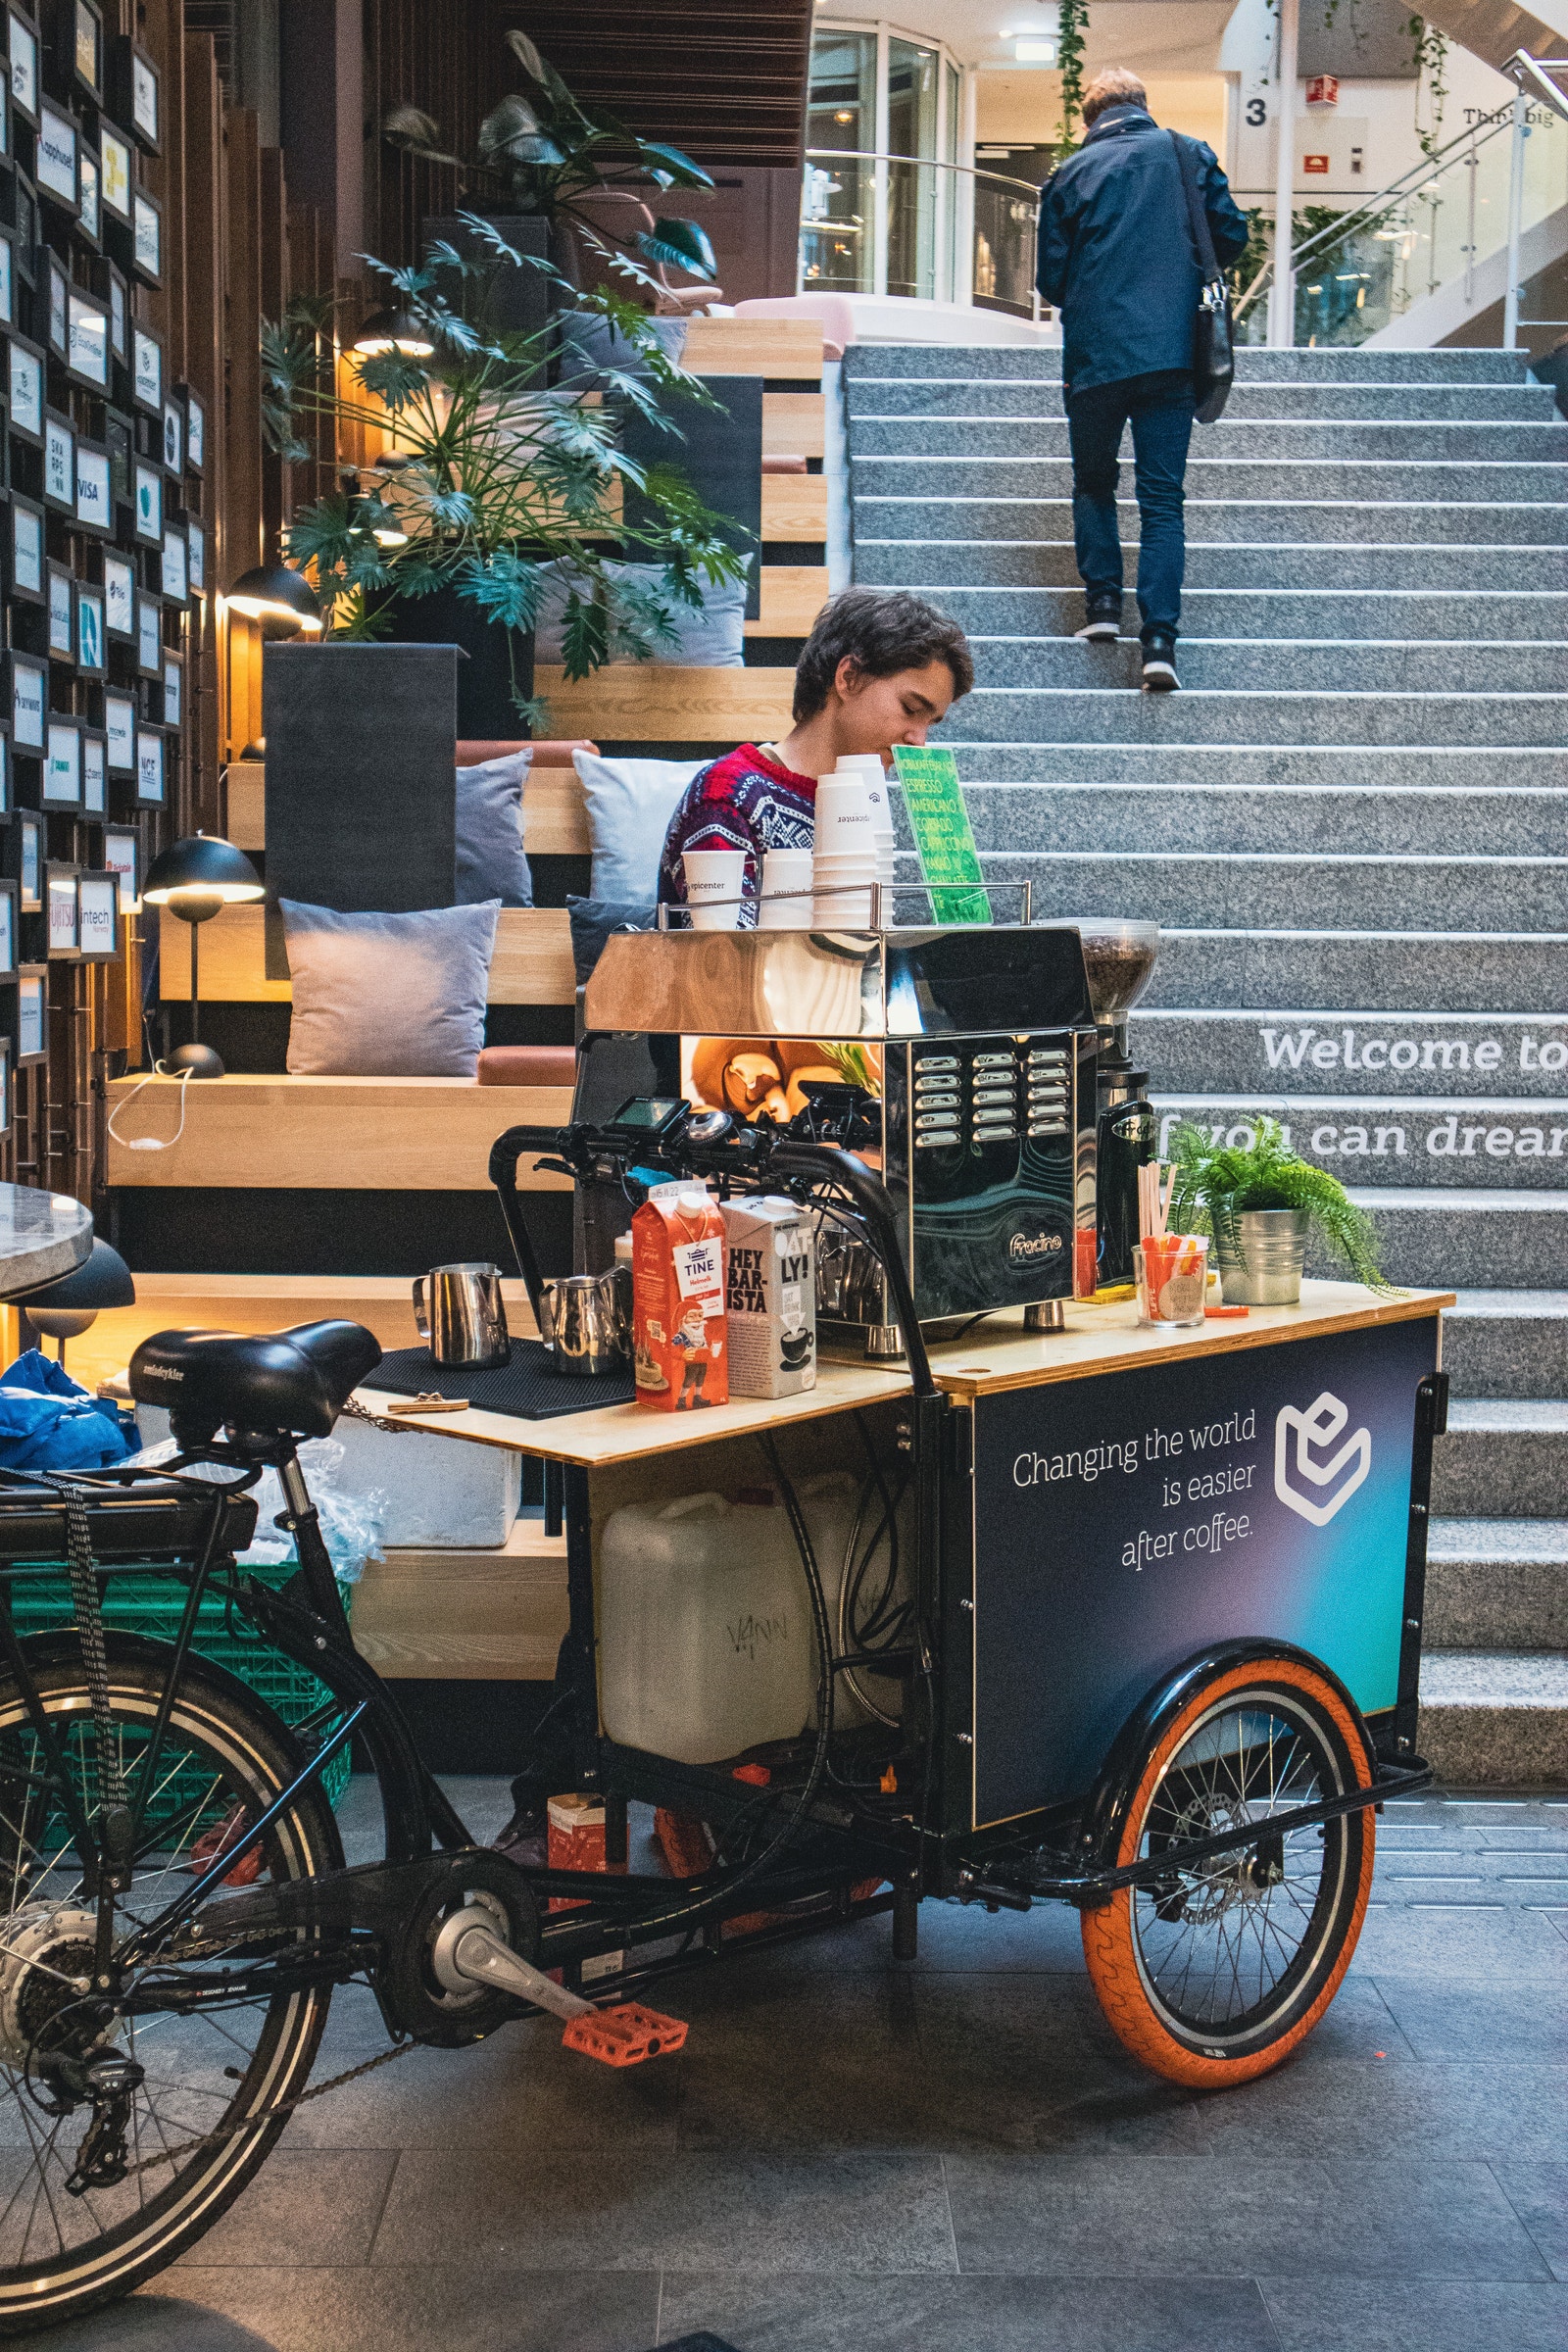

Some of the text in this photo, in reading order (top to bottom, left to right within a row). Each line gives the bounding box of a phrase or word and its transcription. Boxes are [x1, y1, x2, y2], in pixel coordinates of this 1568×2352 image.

[1246, 98, 1266, 126] 3
[1525, 106, 1553, 128] big
[78, 480, 98, 501] VISA
[906, 779, 943, 794] ESPRESSO
[911, 799, 956, 813] AMERICANO
[916, 817, 954, 832] CORTADO
[691, 882, 725, 891] epicenter
[50, 904, 74, 933] UJITSU
[80, 908, 109, 924] intech
[1259, 1029, 1568, 1070] Welcome to
[1311, 1123, 1407, 1156] can
[1009, 1232, 1061, 1256] Fracino
[684, 1259, 714, 1276] TINE
[729, 1248, 763, 1269] HEY
[781, 1254, 808, 1284] LY!
[727, 1267, 768, 1290] BAR-
[726, 1289, 767, 1313] ISTA
[1013, 1409, 1256, 1487] Changing the world
[1162, 1464, 1256, 1507] is easier
[1121, 1513, 1254, 1572] after coffee.
